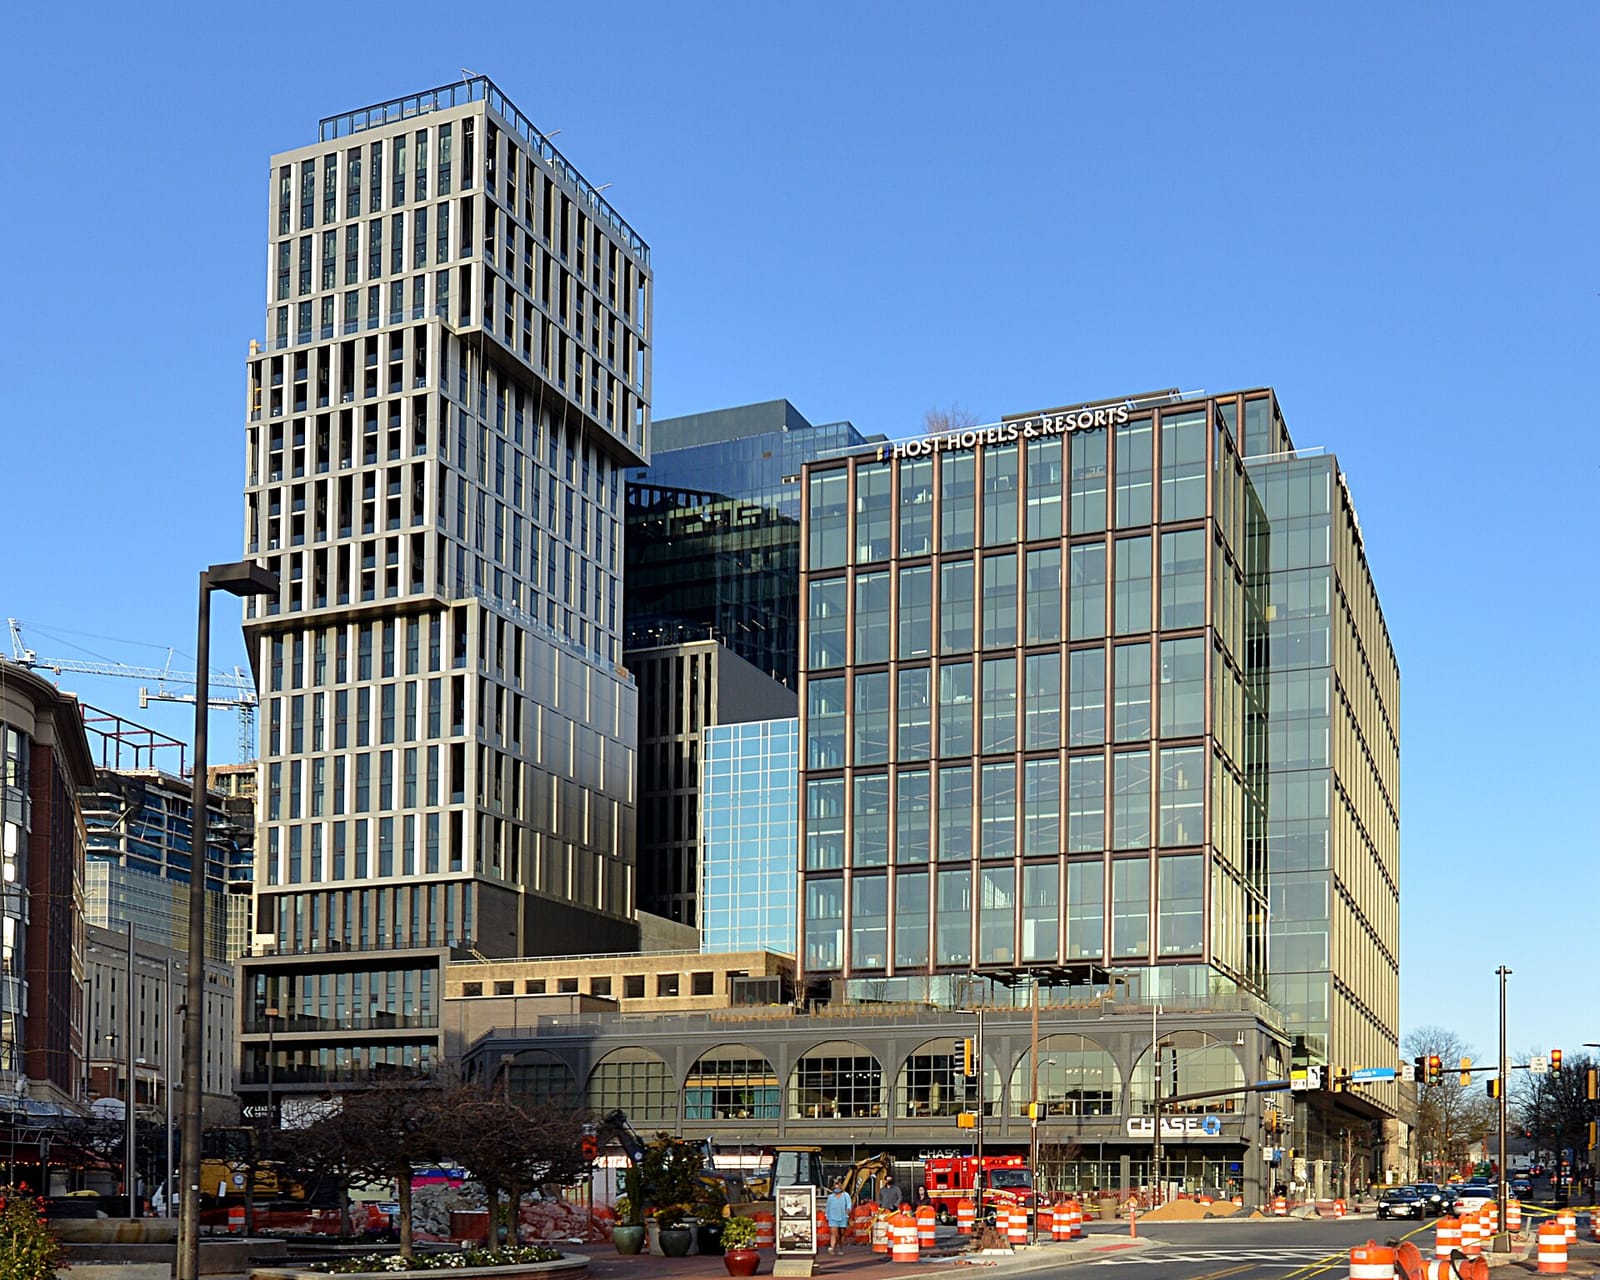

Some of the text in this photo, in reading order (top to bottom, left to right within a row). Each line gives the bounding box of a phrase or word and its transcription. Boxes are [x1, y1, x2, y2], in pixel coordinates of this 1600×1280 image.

[893, 406, 1129, 459] HOST HOTELS & RESORTS
[1126, 1117, 1199, 1133] CHASE
